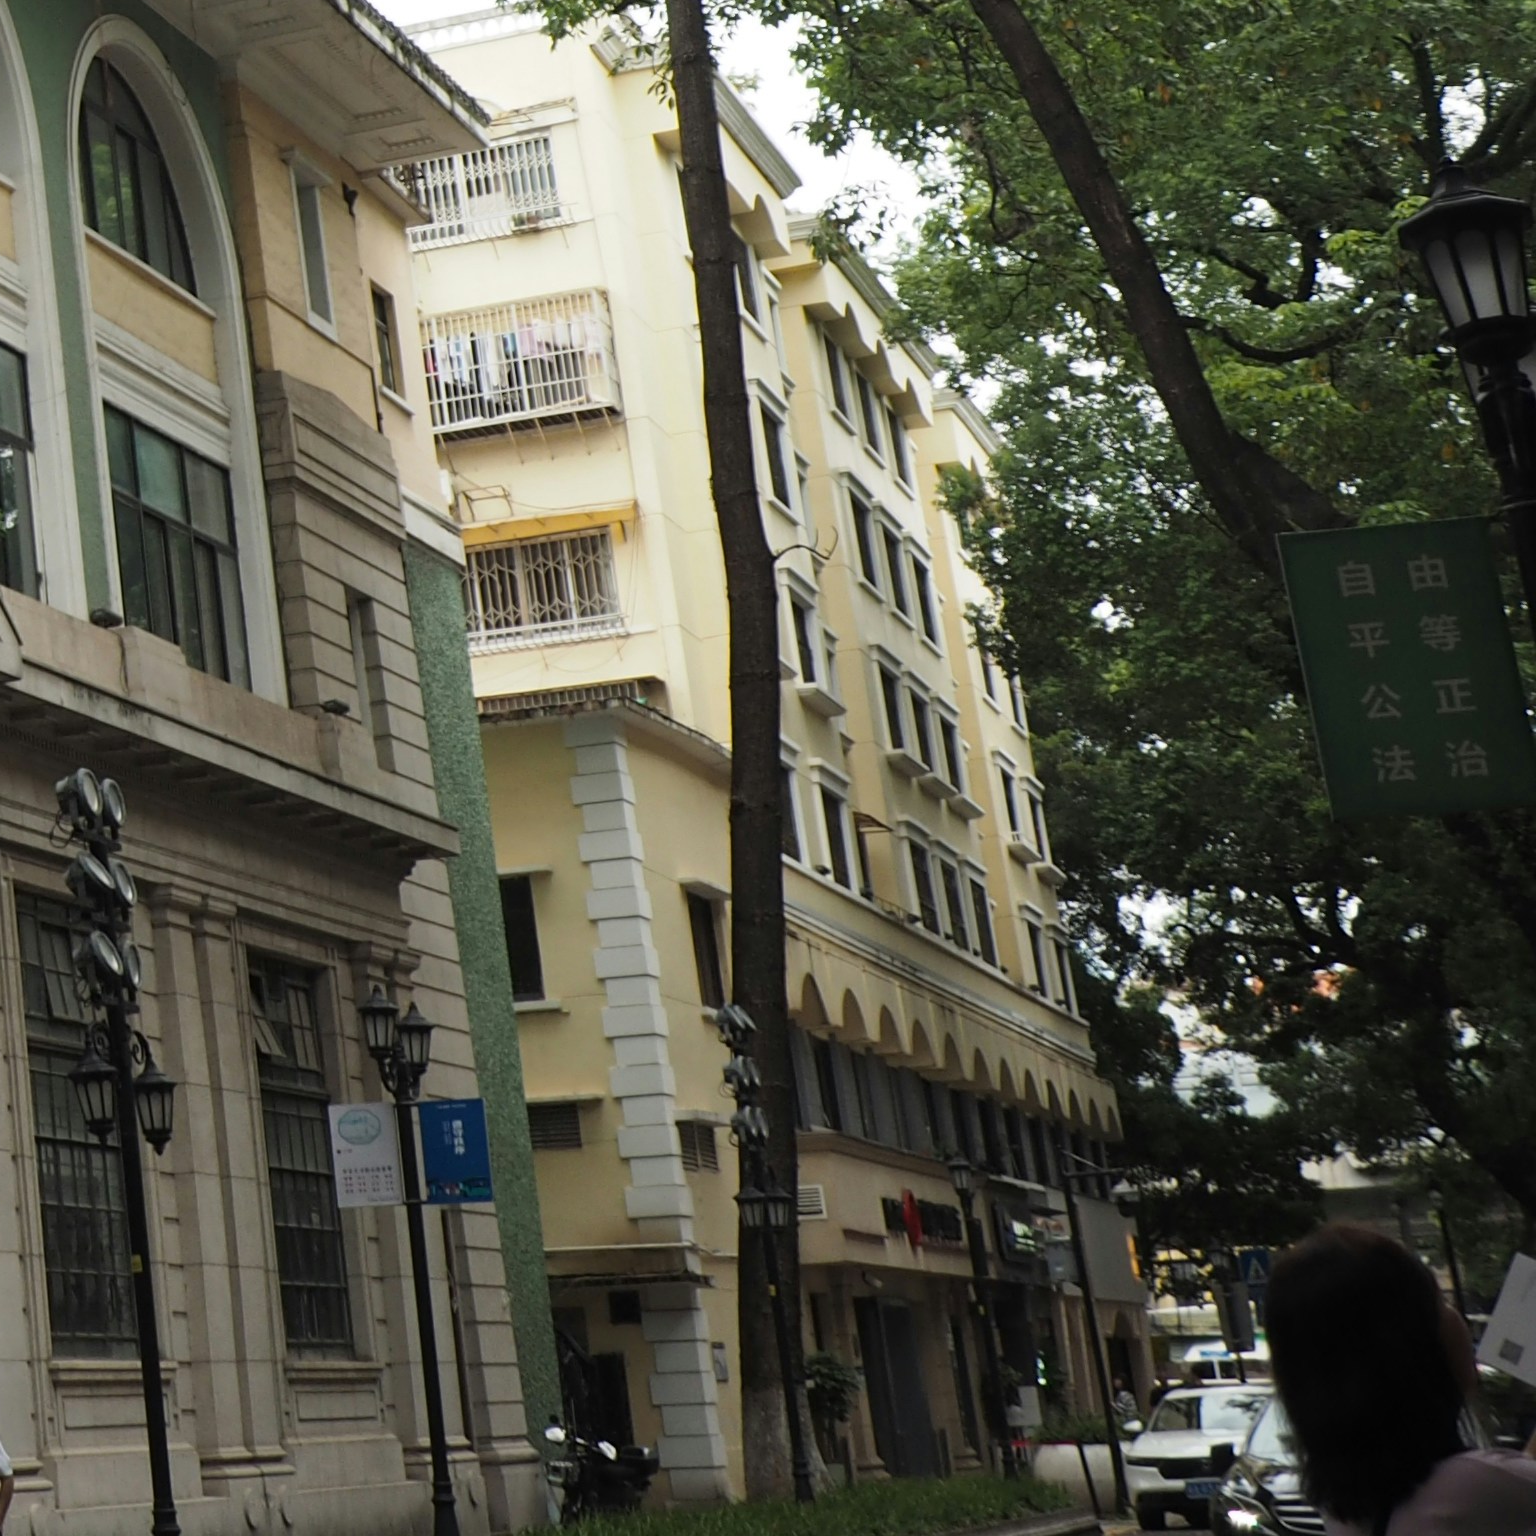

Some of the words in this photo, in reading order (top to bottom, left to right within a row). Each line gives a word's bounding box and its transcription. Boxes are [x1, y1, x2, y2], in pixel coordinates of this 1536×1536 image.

[1336, 554, 1449, 599] 自由
[1348, 614, 1462, 659] 平等
[1361, 677, 1477, 721] 公正
[1372, 740, 1490, 784] 法治
